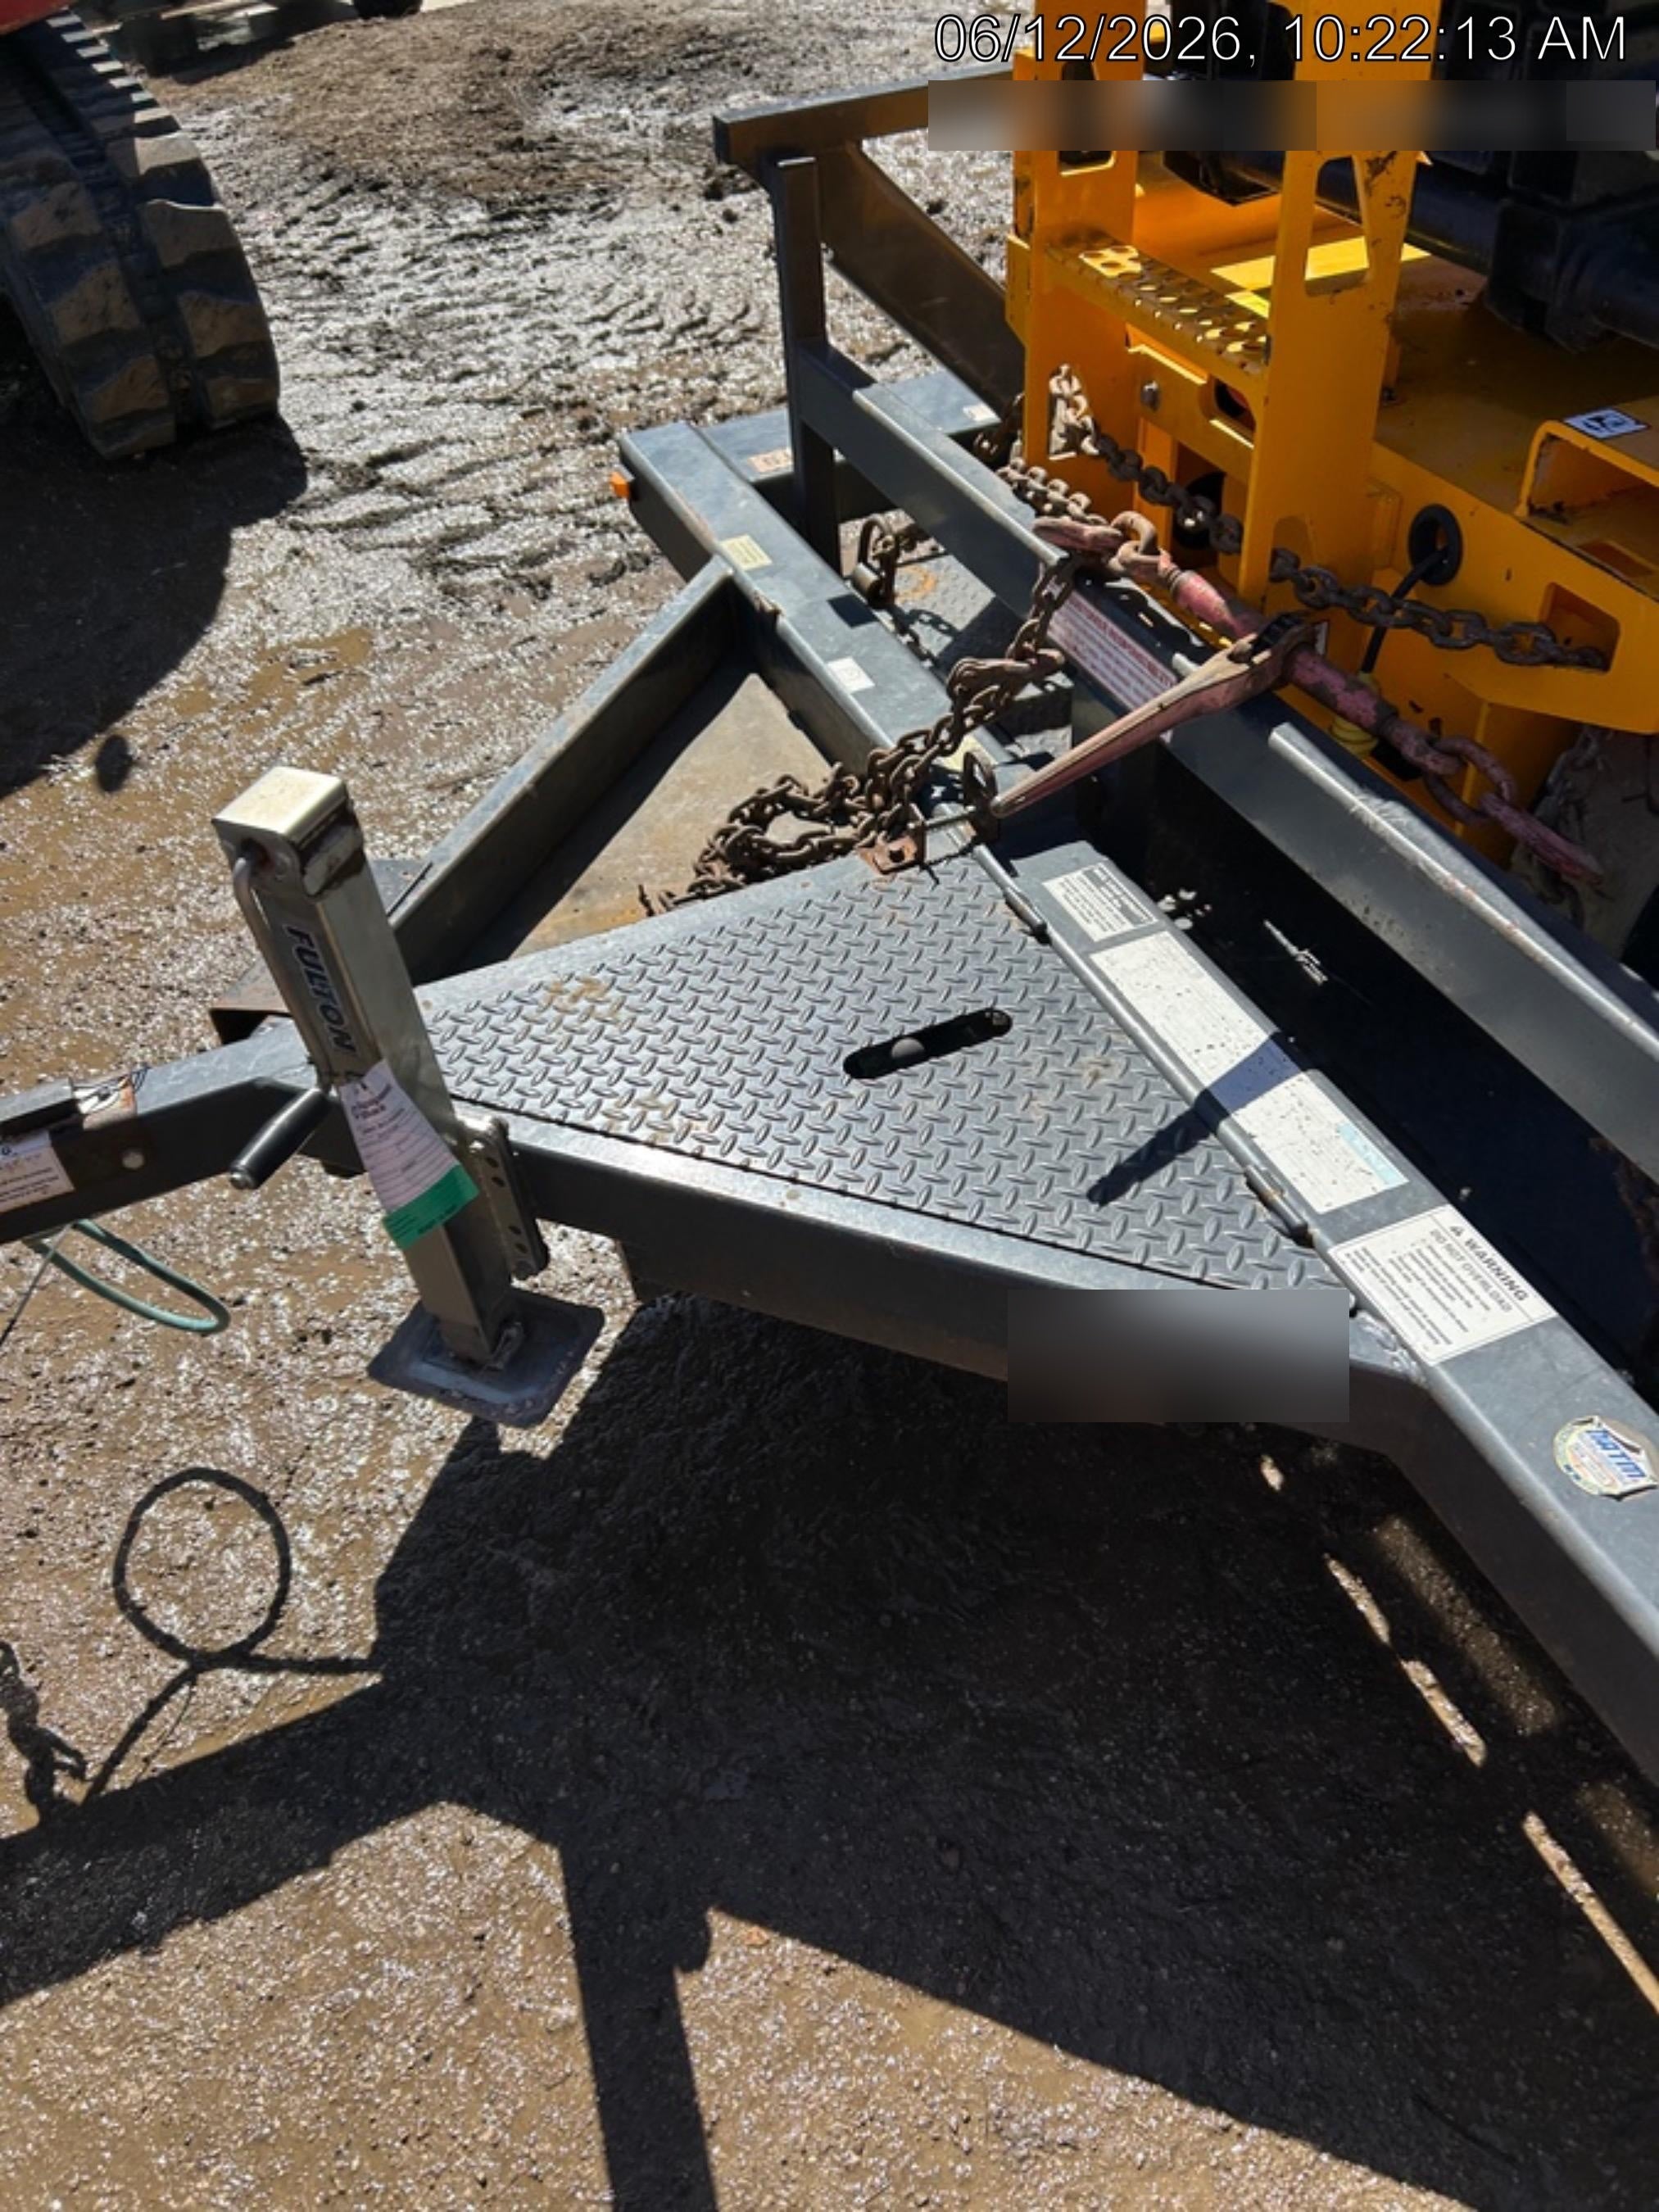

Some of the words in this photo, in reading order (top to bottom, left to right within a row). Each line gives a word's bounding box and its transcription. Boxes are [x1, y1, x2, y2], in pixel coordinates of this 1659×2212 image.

[284, 925, 358, 1053] FULTON
[1430, 1230, 1448, 1244] DO
[1444, 1244, 1466, 1262] NOT
[1461, 1262, 1512, 1312] OVERLOAD
[1464, 1238, 1529, 1301] WARNING
